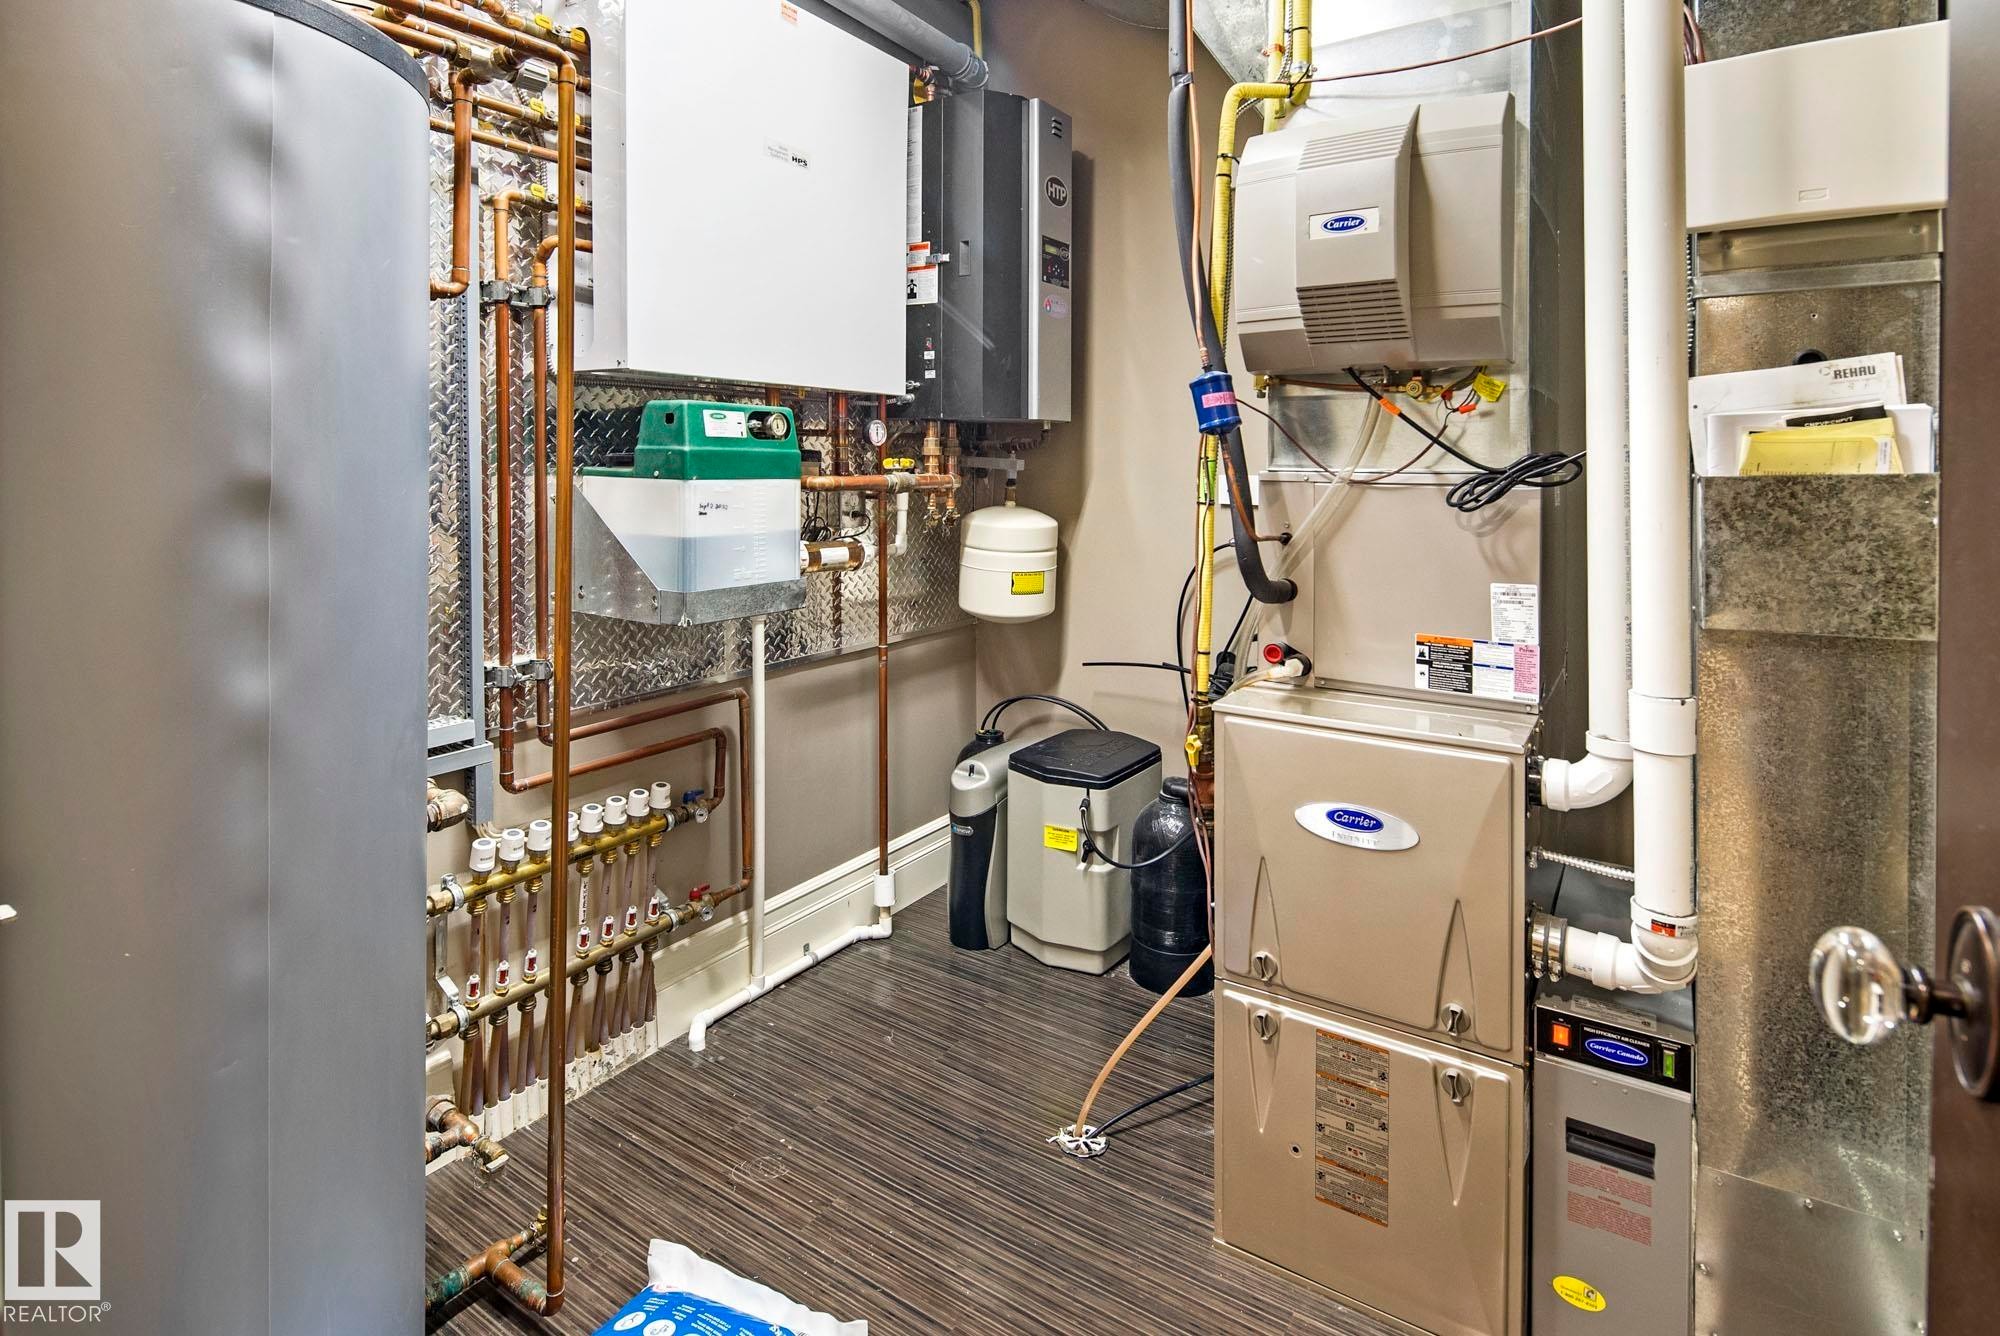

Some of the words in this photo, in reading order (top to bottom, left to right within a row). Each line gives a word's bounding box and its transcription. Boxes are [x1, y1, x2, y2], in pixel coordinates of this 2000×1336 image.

[1047, 181, 1067, 201] HTP
[1326, 218, 1361, 229] Carrier
[1833, 366, 1876, 379] REHAU
[1334, 811, 1376, 828] Carrier
[1590, 1043, 1617, 1053] Carrier
[1616, 1049, 1644, 1062] Canada
